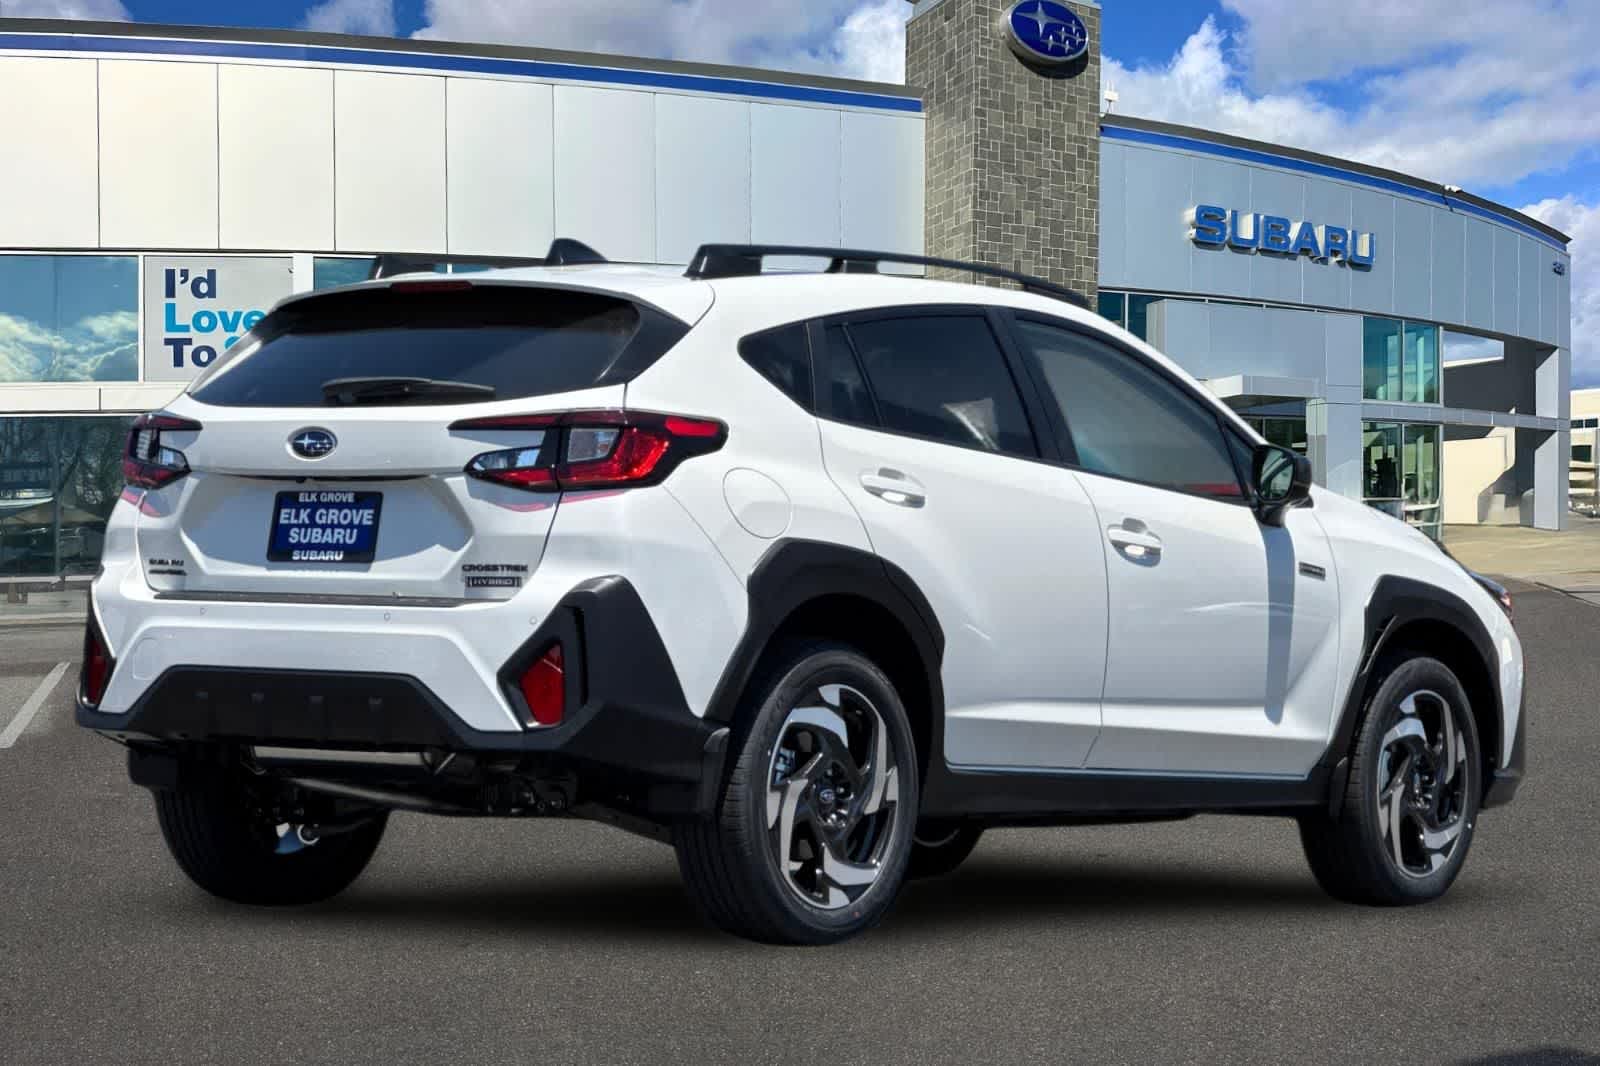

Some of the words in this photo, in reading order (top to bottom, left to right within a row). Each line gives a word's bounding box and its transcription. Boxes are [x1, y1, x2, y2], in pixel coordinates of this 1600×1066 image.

[1191, 204, 1376, 266] SUBARU
[165, 268, 217, 299] I’d
[165, 302, 266, 333] Love
[164, 337, 217, 368] To
[298, 492, 317, 503] ELK
[320, 492, 355, 503] GROVE
[279, 508, 311, 524] ELK
[315, 508, 374, 526] GROVE
[288, 527, 357, 544] SUBARU
[292, 550, 344, 561] SUBARU
[461, 563, 529, 573] CROSSTREK
